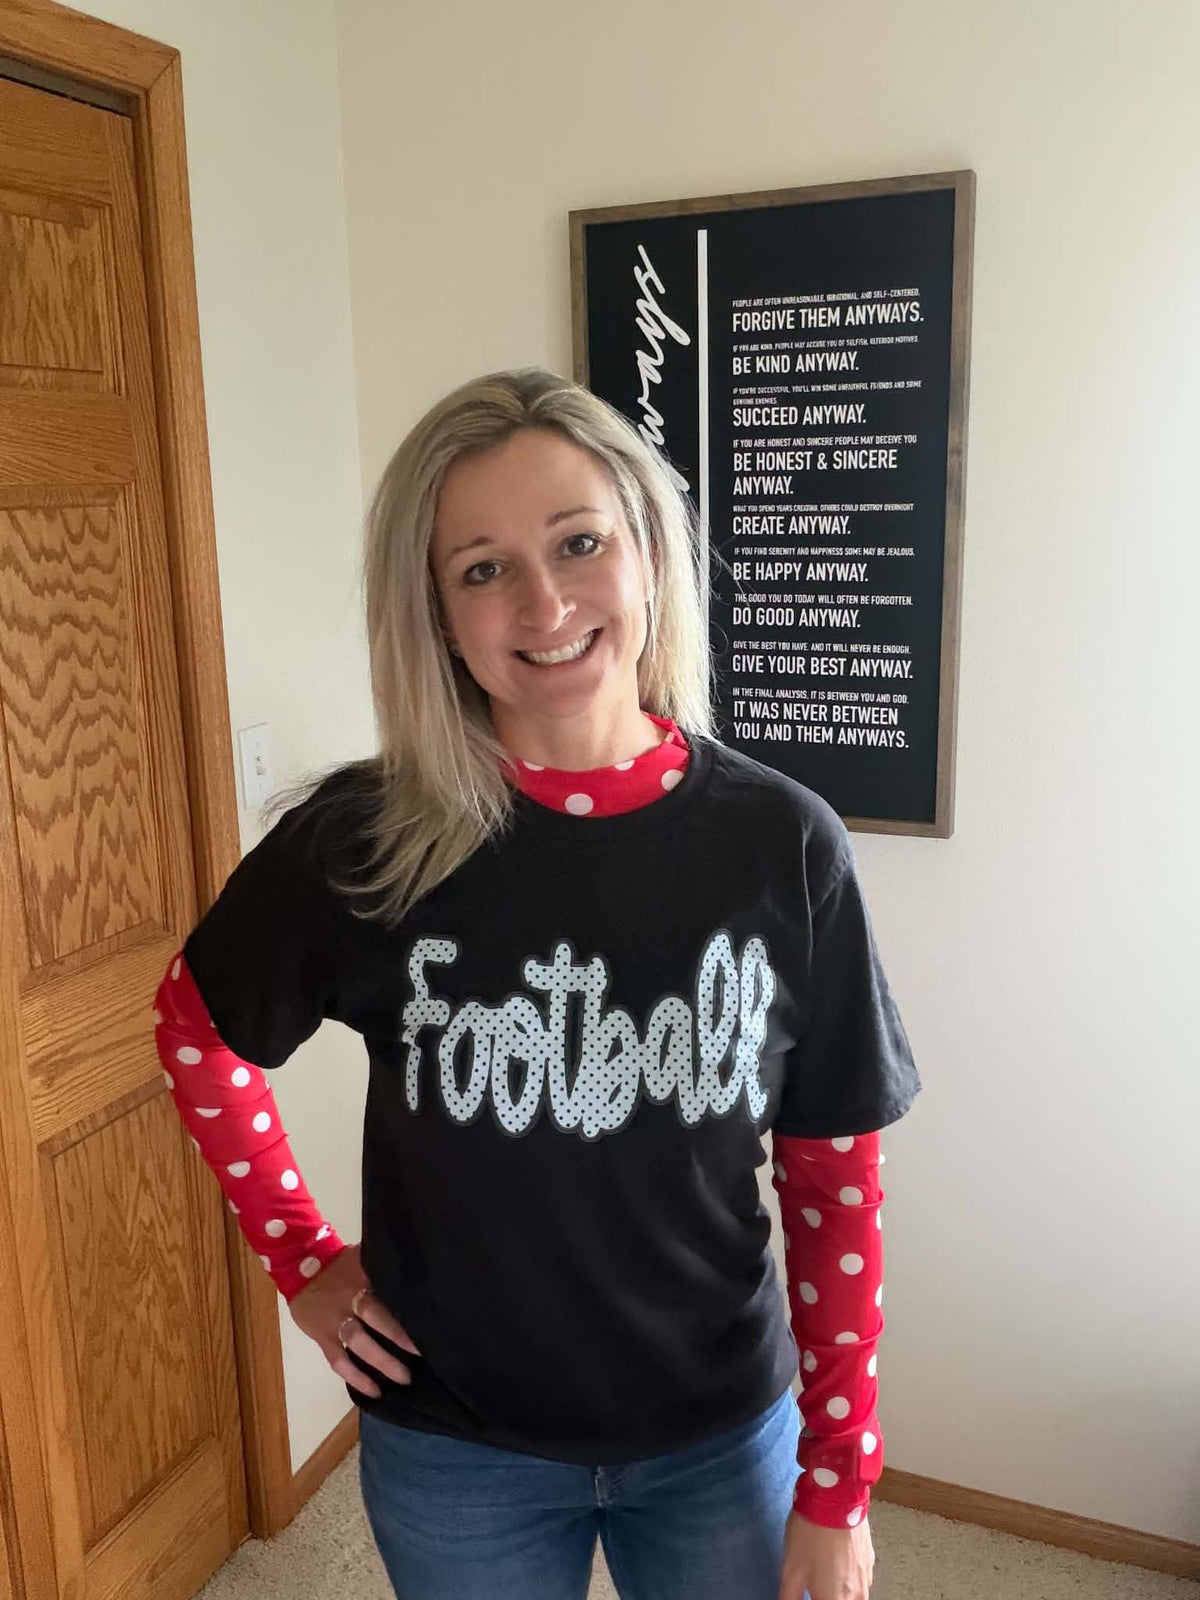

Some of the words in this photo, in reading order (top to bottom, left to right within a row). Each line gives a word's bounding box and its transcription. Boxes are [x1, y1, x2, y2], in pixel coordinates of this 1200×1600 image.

[732, 299, 752, 307] PEOPLE
[752, 298, 764, 306] ARE
[764, 297, 781, 306] OFTEN
[861, 291, 872, 299] AND
[732, 310, 795, 332] FORGIVE
[799, 306, 840, 329] THEM
[845, 301, 924, 326] ANYWAYS.
[633, 244, 691, 491] ways
[732, 357, 752, 376] BE
[756, 354, 790, 374] KIND
[795, 351, 859, 373] ANYWAY.
[732, 406, 798, 427] SUCCEED
[802, 404, 866, 425] ANYWAY.
[732, 440, 740, 448] IF
[740, 440, 752, 448] YOU
[754, 439, 766, 448] ARE
[768, 438, 791, 447] HONEST
[792, 438, 806, 446] AND
[807, 437, 834, 446] SINCERE
[835, 436, 860, 445] PEOPLE
[860, 436, 874, 444] MAY
[876, 435, 902, 444] DECEIVE
[904, 434, 917, 444] YOU
[734, 452, 752, 472] BE
[756, 451, 813, 471] HONEST
[817, 452, 828, 470] &
[832, 449, 898, 470] SINCERE
[732, 476, 794, 495] ANYWAY.
[860, 504, 883, 512] DESTROY
[884, 504, 914, 512] OVERNIGHT
[732, 516, 785, 535] CREATE
[788, 516, 851, 535] ANYWAY.
[768, 548, 796, 556] SERENITY
[797, 548, 809, 556] AND
[810, 548, 844, 556] HAPPINESS
[844, 548, 862, 556] SOME
[863, 548, 876, 556] MAY
[877, 548, 886, 556] BE
[733, 562, 751, 581] BE
[755, 562, 802, 581] HAPPY
[806, 562, 868, 582] ANYWAY.
[734, 594, 748, 602] THE
[748, 594, 766, 602] GOOD
[768, 594, 782, 602] YOU
[783, 594, 792, 603] DO
[818, 595, 835, 604] WILL
[836, 595, 858, 604] OFTEN
[860, 596, 870, 604] BE
[732, 607, 752, 625] DO
[756, 607, 794, 626] GOOD
[799, 608, 860, 628] ANYWAY.
[733, 641, 747, 650] GIVE
[748, 642, 760, 650] THE
[761, 642, 776, 650] BEST
[778, 642, 790, 650] YOU
[811, 644, 824, 652] AND
[826, 644, 832, 652] IT
[832, 644, 848, 652] WILL
[850, 644, 870, 653] NEVER
[872, 645, 882, 654] BE
[732, 654, 764, 673] GIVE
[768, 656, 806, 674] YOUR
[810, 657, 846, 676] BEST
[850, 658, 913, 679] ANYWAY.
[732, 688, 740, 696] IN
[741, 688, 754, 697] THE
[755, 688, 774, 698] FINAL
[810, 690, 817, 700] IT
[819, 690, 826, 700] IS
[827, 692, 858, 701] BETWEEN
[860, 692, 874, 702] YOU
[876, 694, 890, 702] AND
[892, 694, 909, 704] GOD.
[734, 700, 746, 718] IT
[749, 702, 778, 720] WAS
[783, 703, 828, 722] NEVER
[832, 705, 898, 726] BETWEEN
[733, 722, 760, 740] YOU
[764, 724, 792, 741] AND
[796, 725, 833, 744] THEM
[837, 728, 909, 748] ANYWAYS.
[401, 930, 776, 1139] Football
